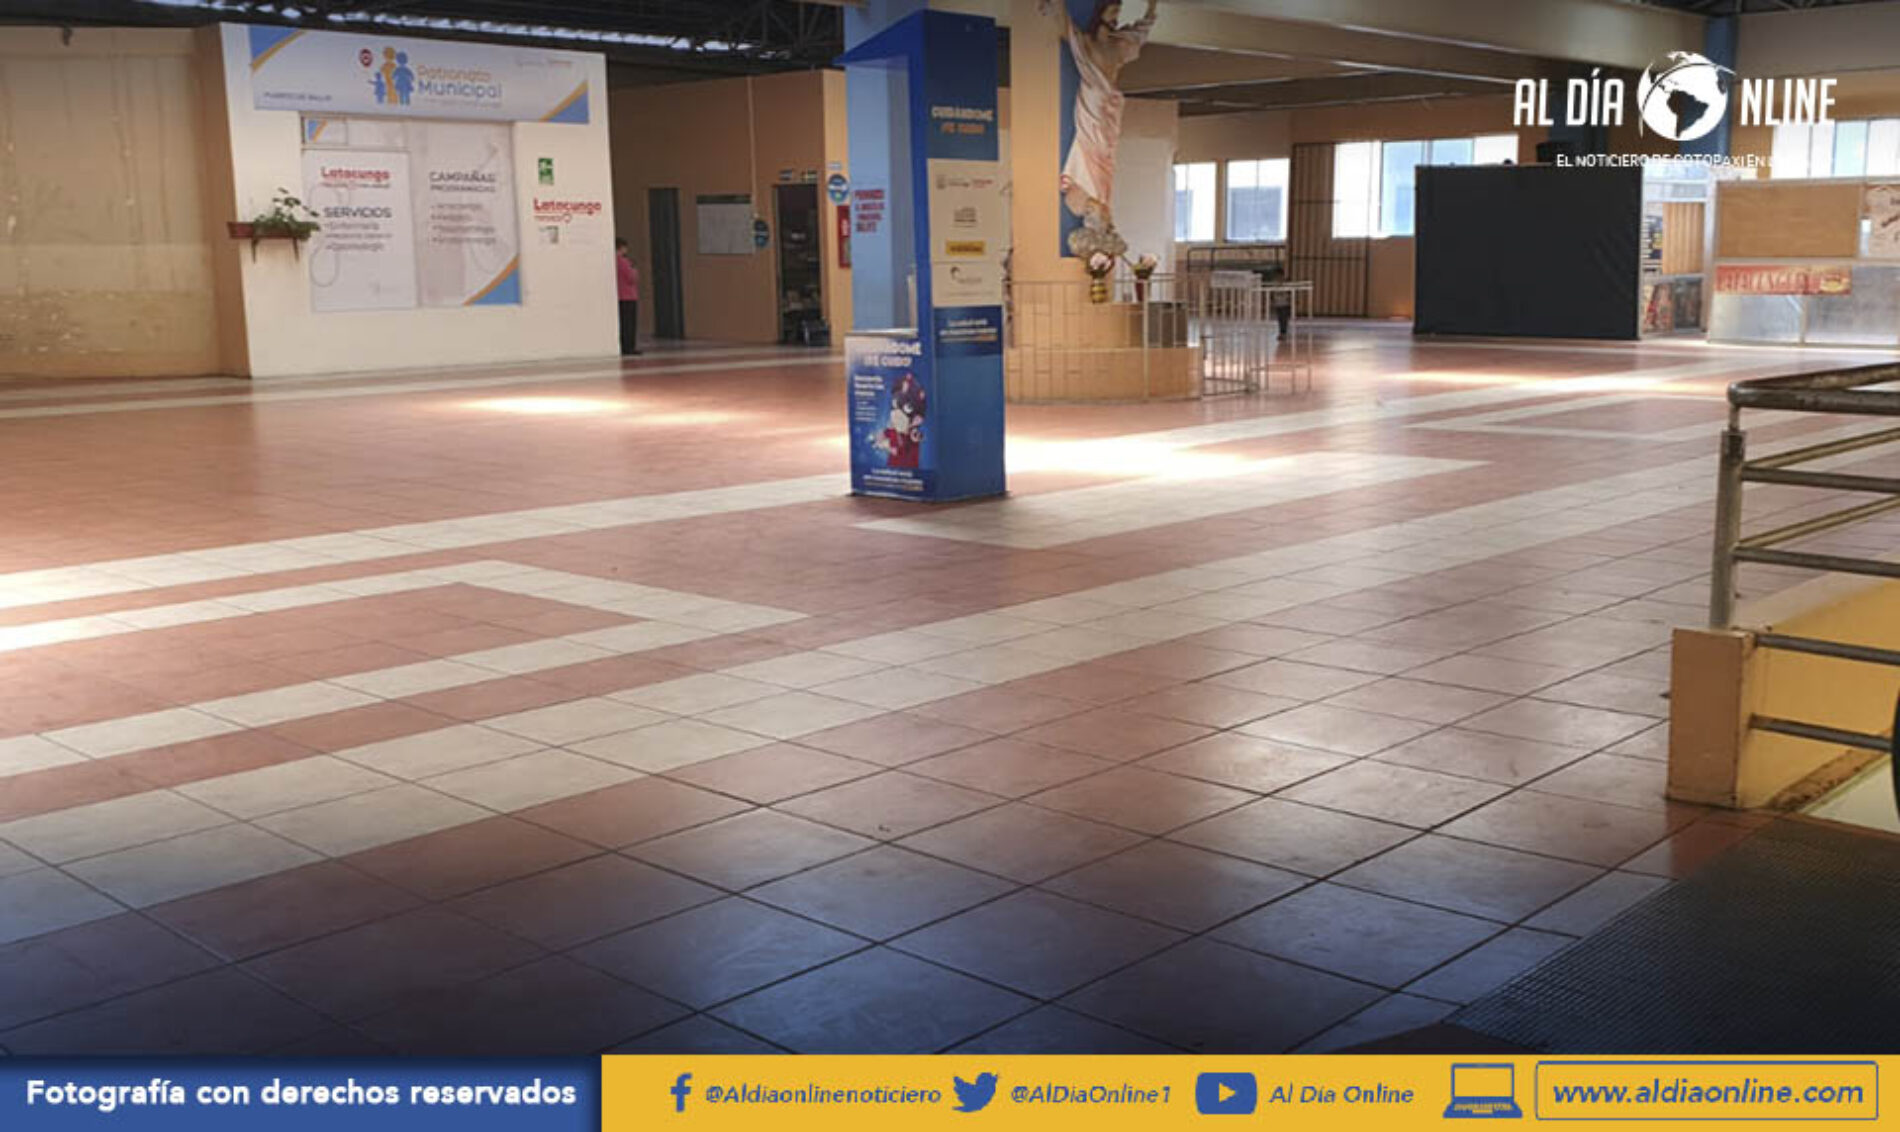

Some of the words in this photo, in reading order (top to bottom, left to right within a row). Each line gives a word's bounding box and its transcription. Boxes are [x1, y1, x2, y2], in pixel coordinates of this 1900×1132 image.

[418, 80, 502, 99] Municipal
[429, 170, 496, 183] CAMPAÑAS
[323, 206, 392, 218] SERVICIOS
